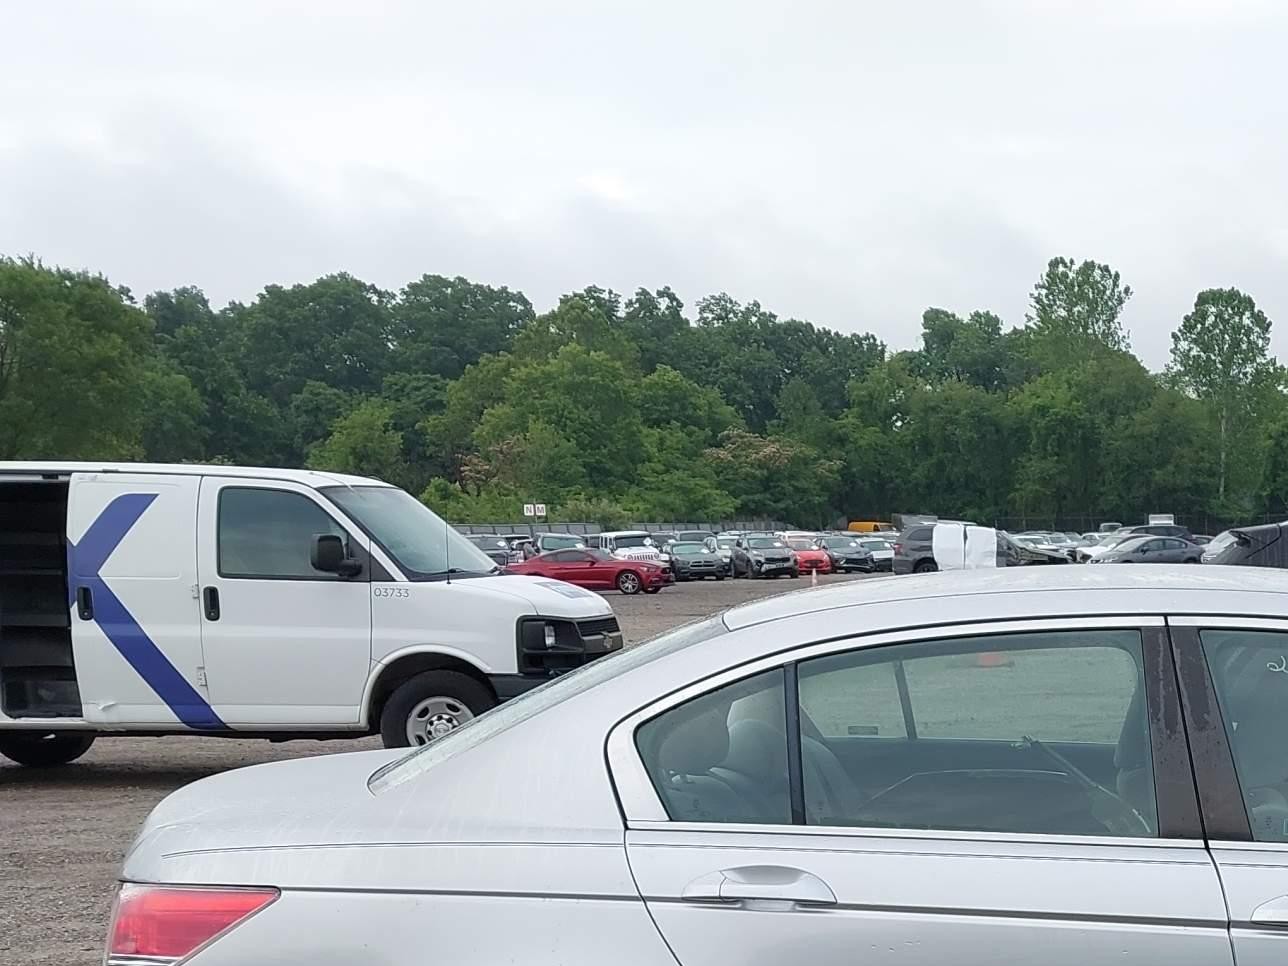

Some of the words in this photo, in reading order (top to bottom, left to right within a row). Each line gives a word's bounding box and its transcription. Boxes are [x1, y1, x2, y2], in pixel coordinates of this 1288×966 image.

[525, 506, 533, 514] N
[536, 506, 545, 514] M
[374, 587, 410, 598] 03733
